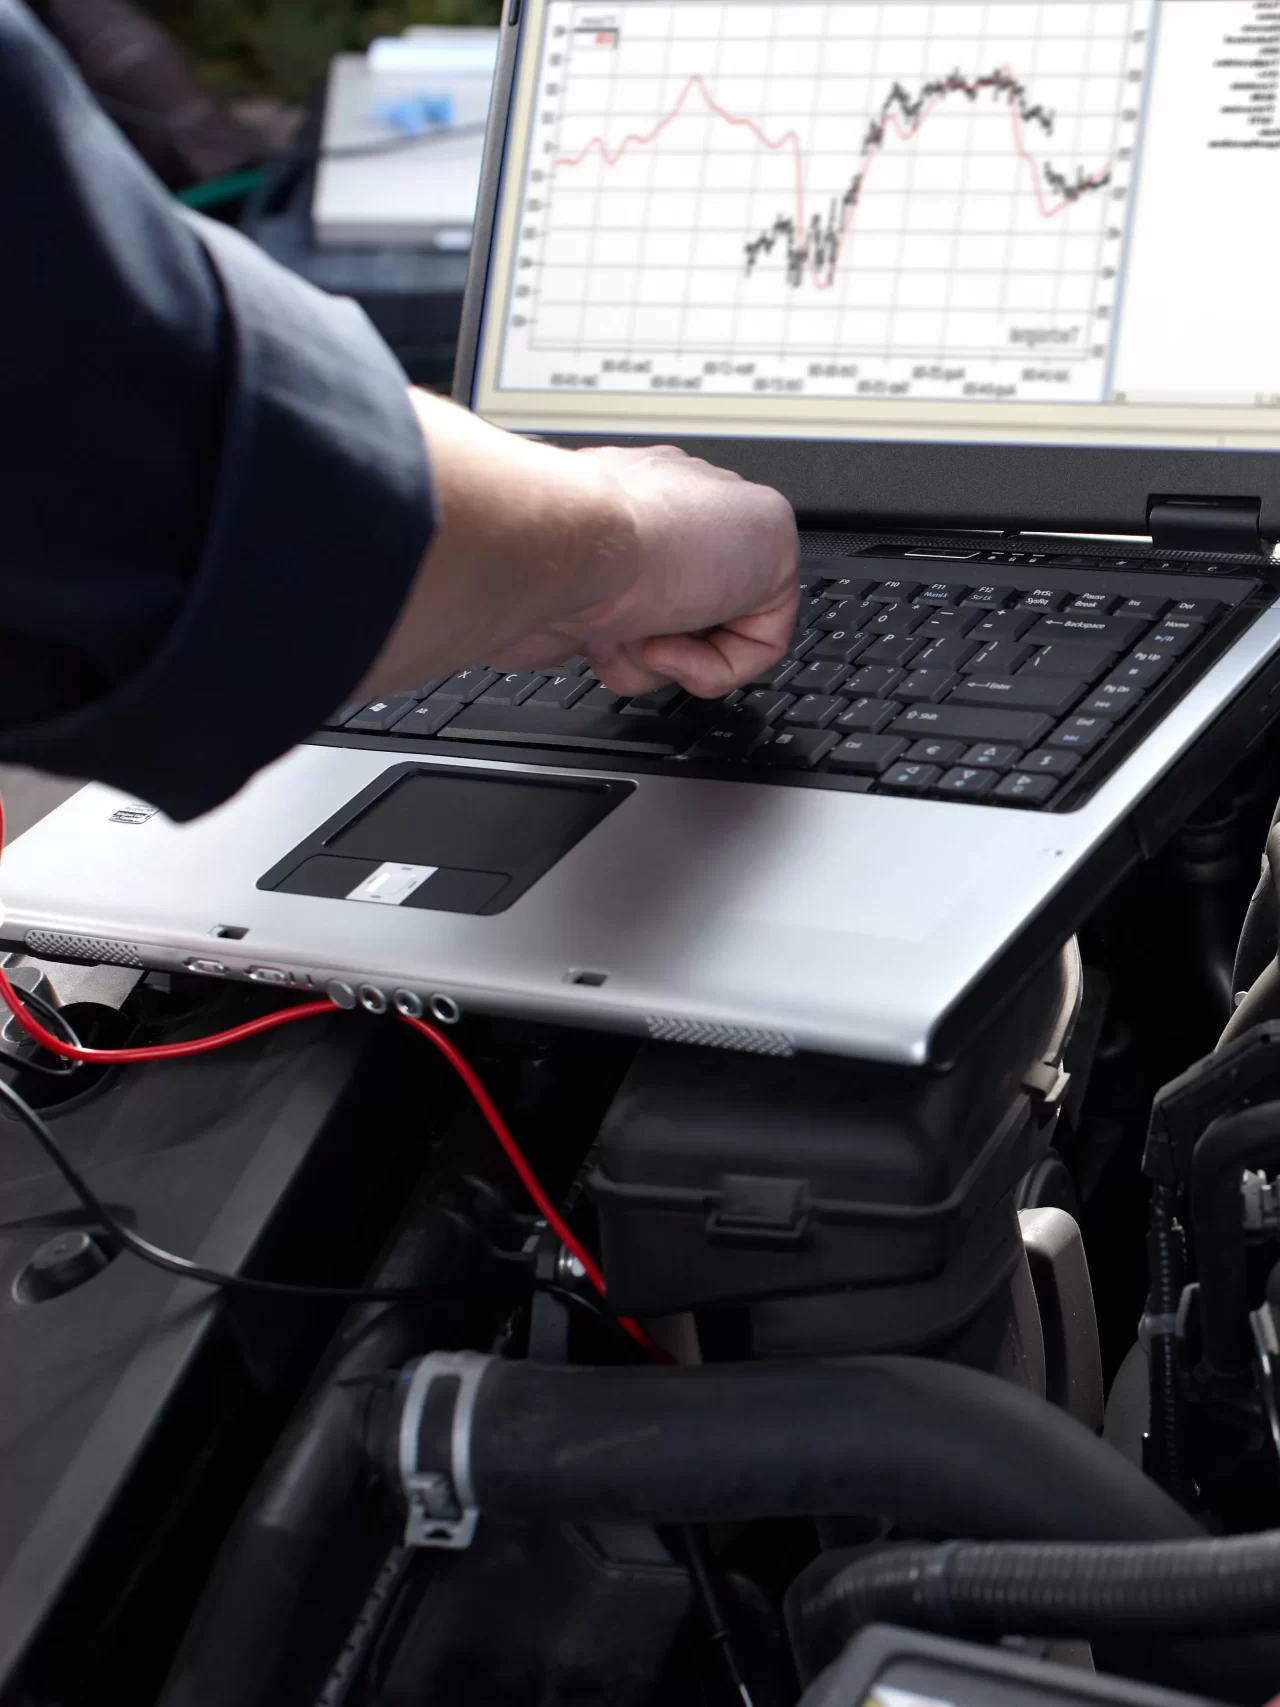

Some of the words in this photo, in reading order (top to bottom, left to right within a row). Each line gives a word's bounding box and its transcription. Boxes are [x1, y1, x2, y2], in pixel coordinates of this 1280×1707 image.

[1033, 589, 1054, 597] PrtSc
[1082, 592, 1106, 600] Pause
[1025, 597, 1049, 606] SysRq
[1074, 600, 1098, 608] Break
[1128, 599, 1142, 607] Ins
[1179, 602, 1195, 610] Del
[826, 611, 837, 619] 9
[1063, 620, 1106, 630] Backspace
[1165, 621, 1190, 629] Home
[882, 634, 895, 642] P
[810, 662, 820, 671] L
[457, 670, 472, 679] X
[505, 674, 518, 682] C
[554, 676, 567, 685] V
